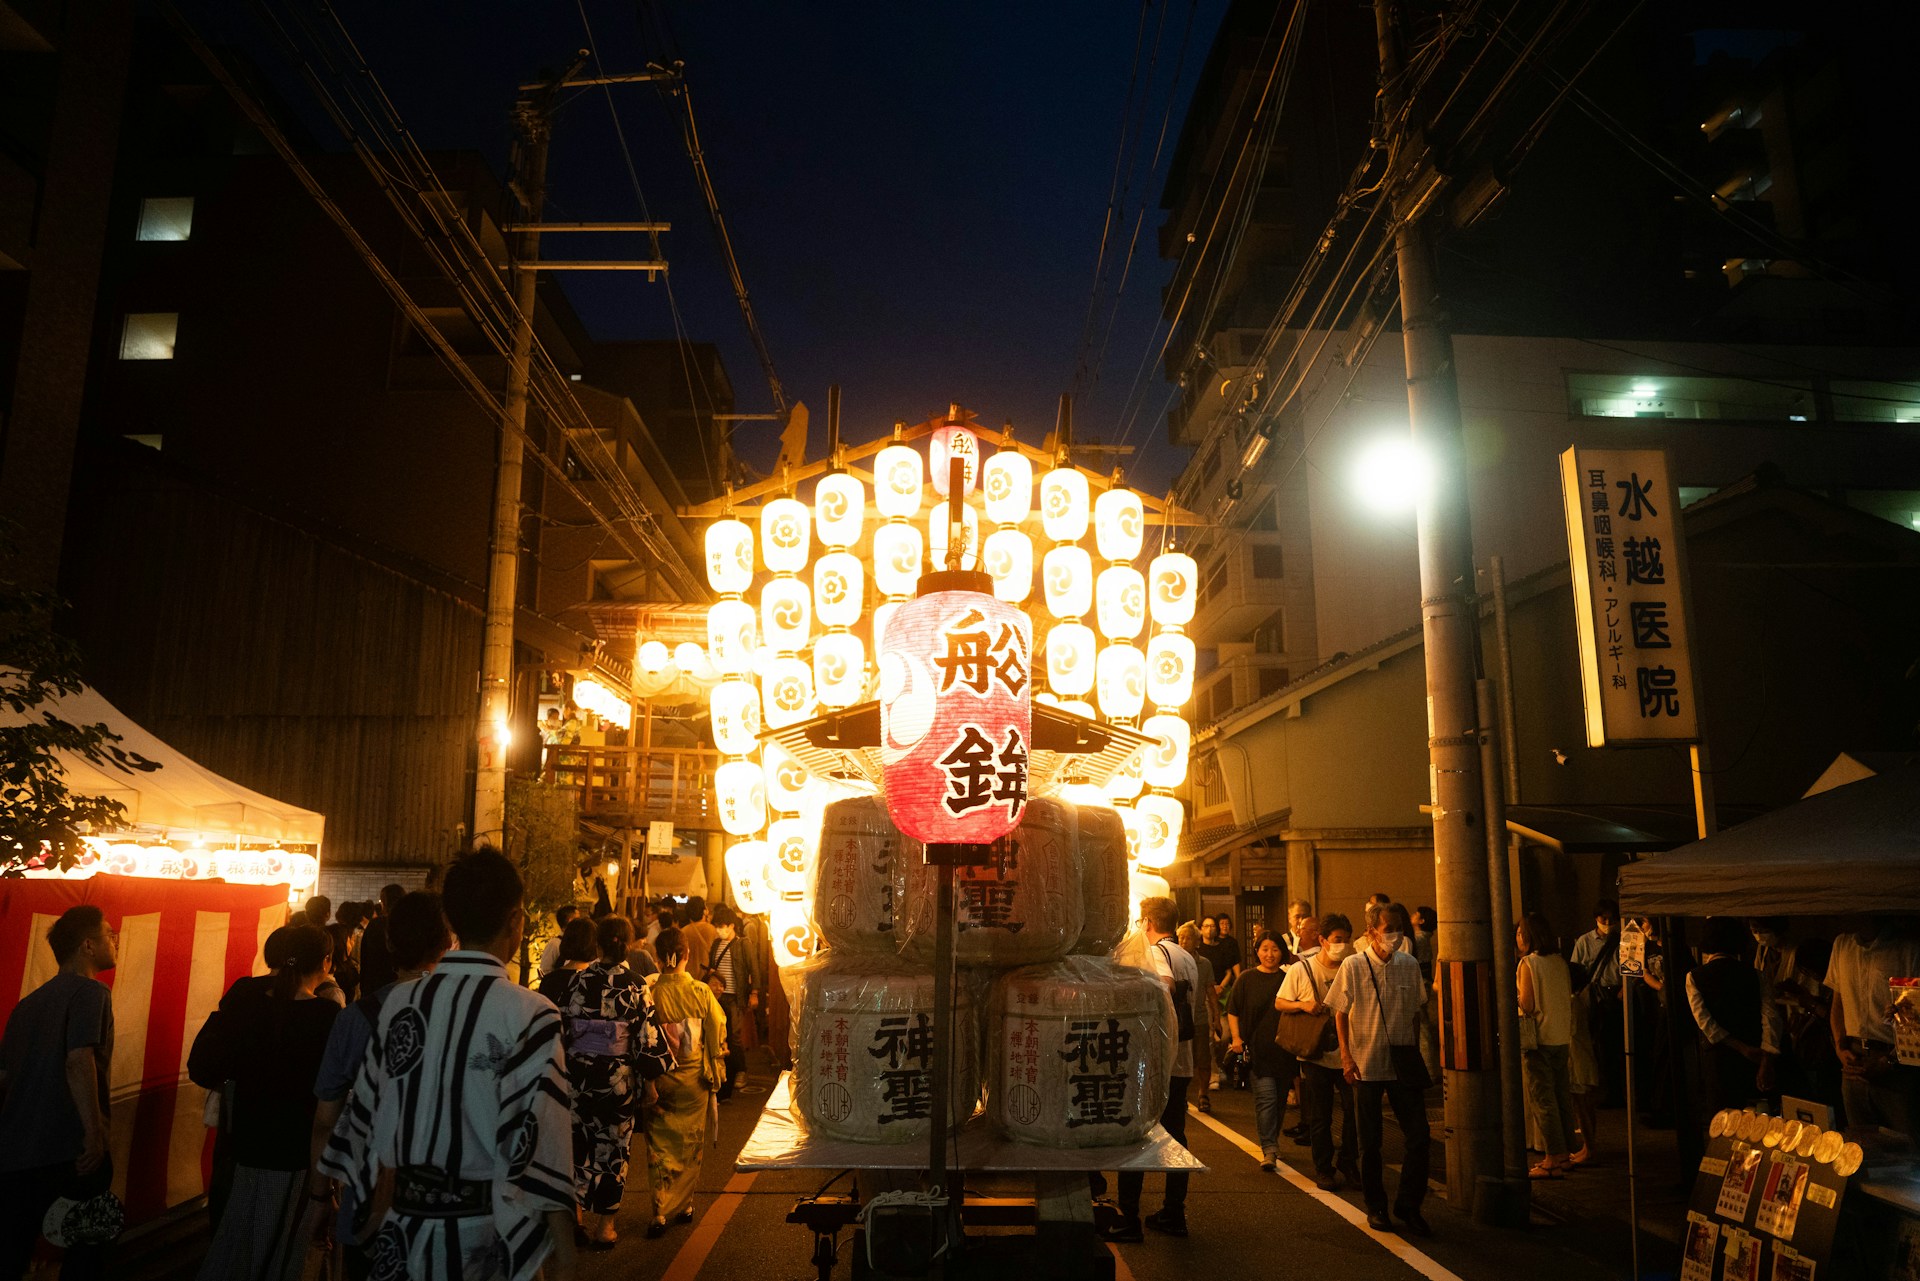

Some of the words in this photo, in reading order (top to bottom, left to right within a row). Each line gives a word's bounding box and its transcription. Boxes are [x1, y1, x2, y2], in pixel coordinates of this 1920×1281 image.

[1616, 472, 1680, 718] 水越医院
[933, 609, 1028, 819] 船鉾
[867, 1013, 934, 1125] 神聖
[1057, 1017, 1132, 1128] 神聖
